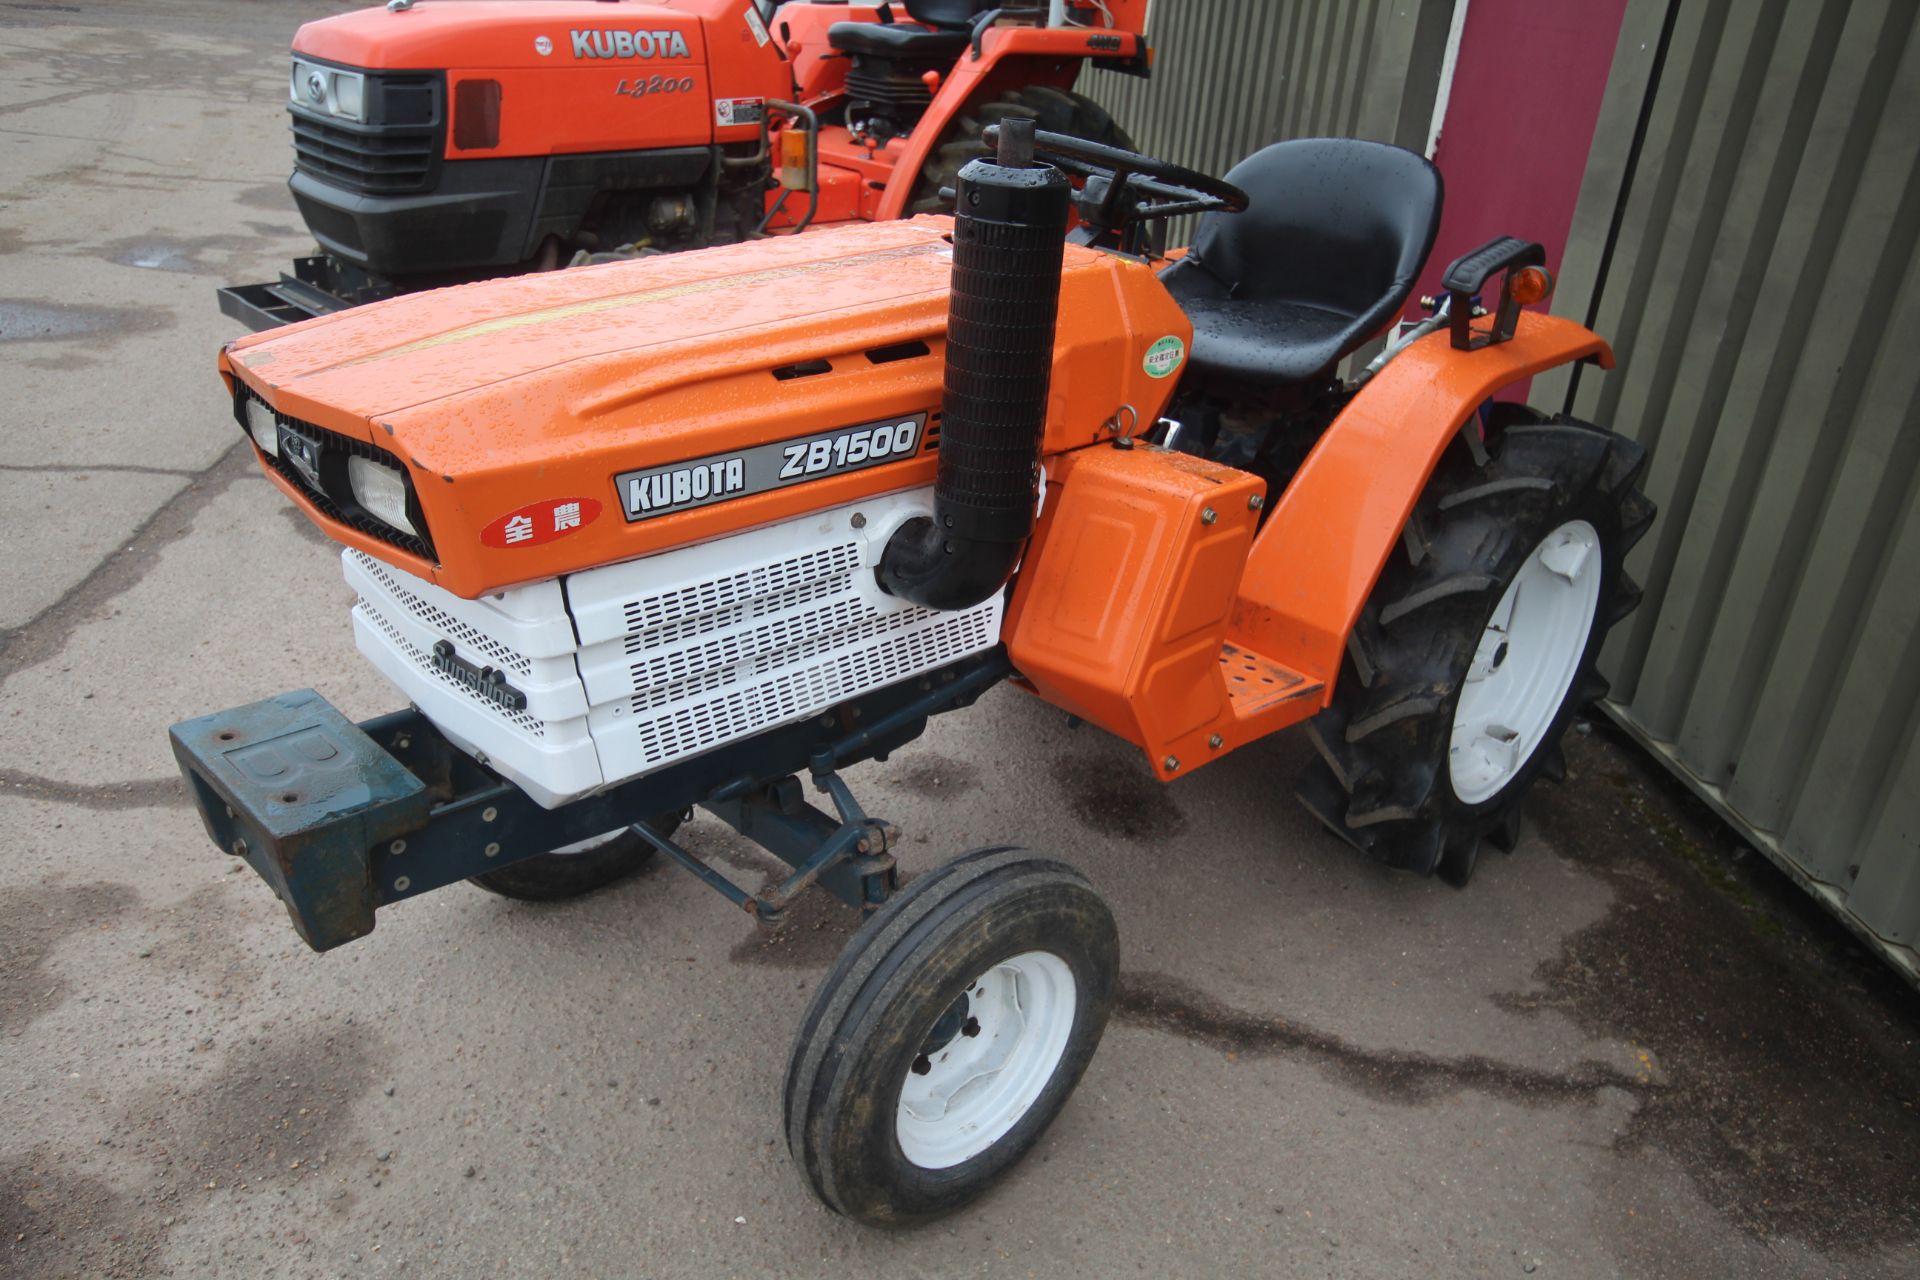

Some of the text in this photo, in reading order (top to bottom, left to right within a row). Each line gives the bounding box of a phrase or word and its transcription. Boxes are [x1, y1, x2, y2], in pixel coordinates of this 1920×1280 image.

[570, 30, 690, 58] KUBOTA
[616, 75, 694, 97] L3200
[629, 421, 917, 515] KUBOTA ZB1500
[431, 642, 517, 711] Sunshine
